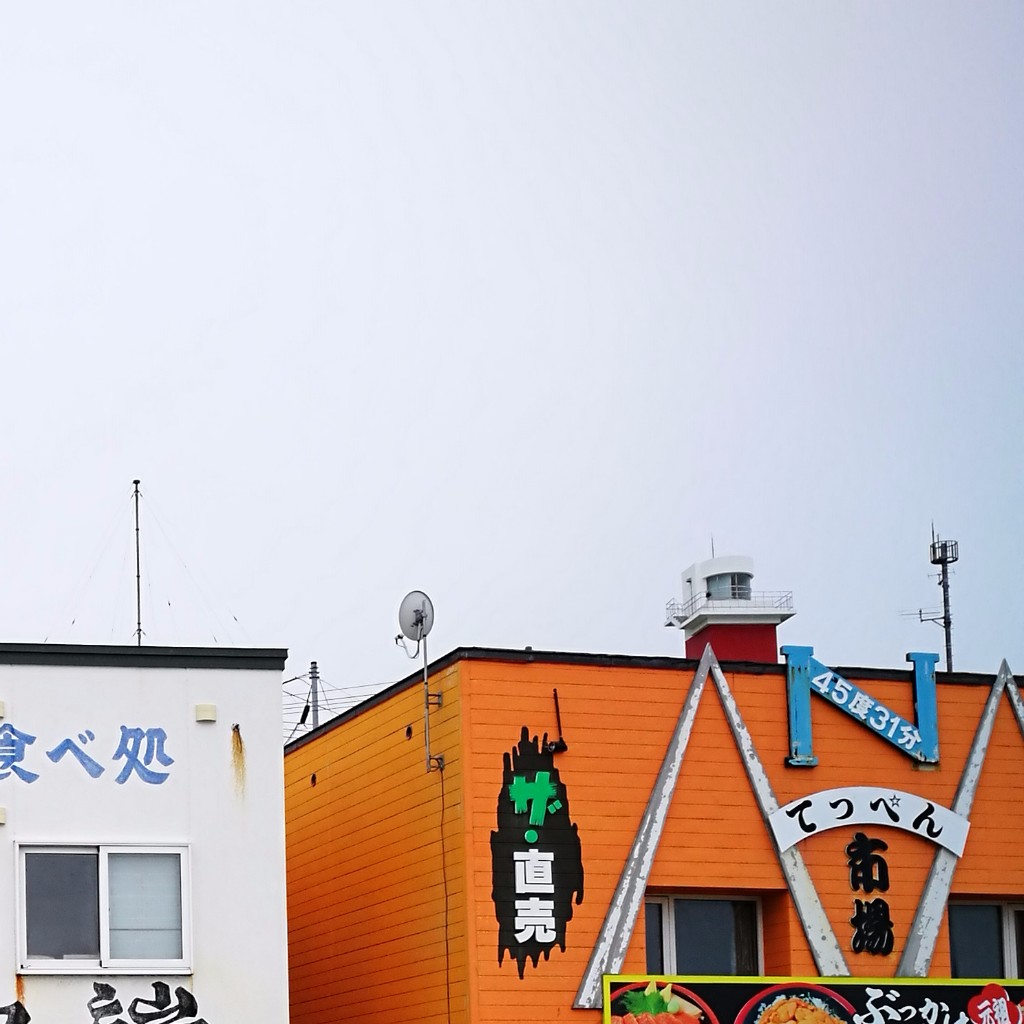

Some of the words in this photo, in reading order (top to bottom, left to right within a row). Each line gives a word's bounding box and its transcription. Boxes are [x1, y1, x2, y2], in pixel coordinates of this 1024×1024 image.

[811, 668, 922, 750] 45度31分
[509, 771, 563, 944] ザ・直売
[785, 795, 944, 840] てっぺん
[845, 832, 894, 956] 市場
